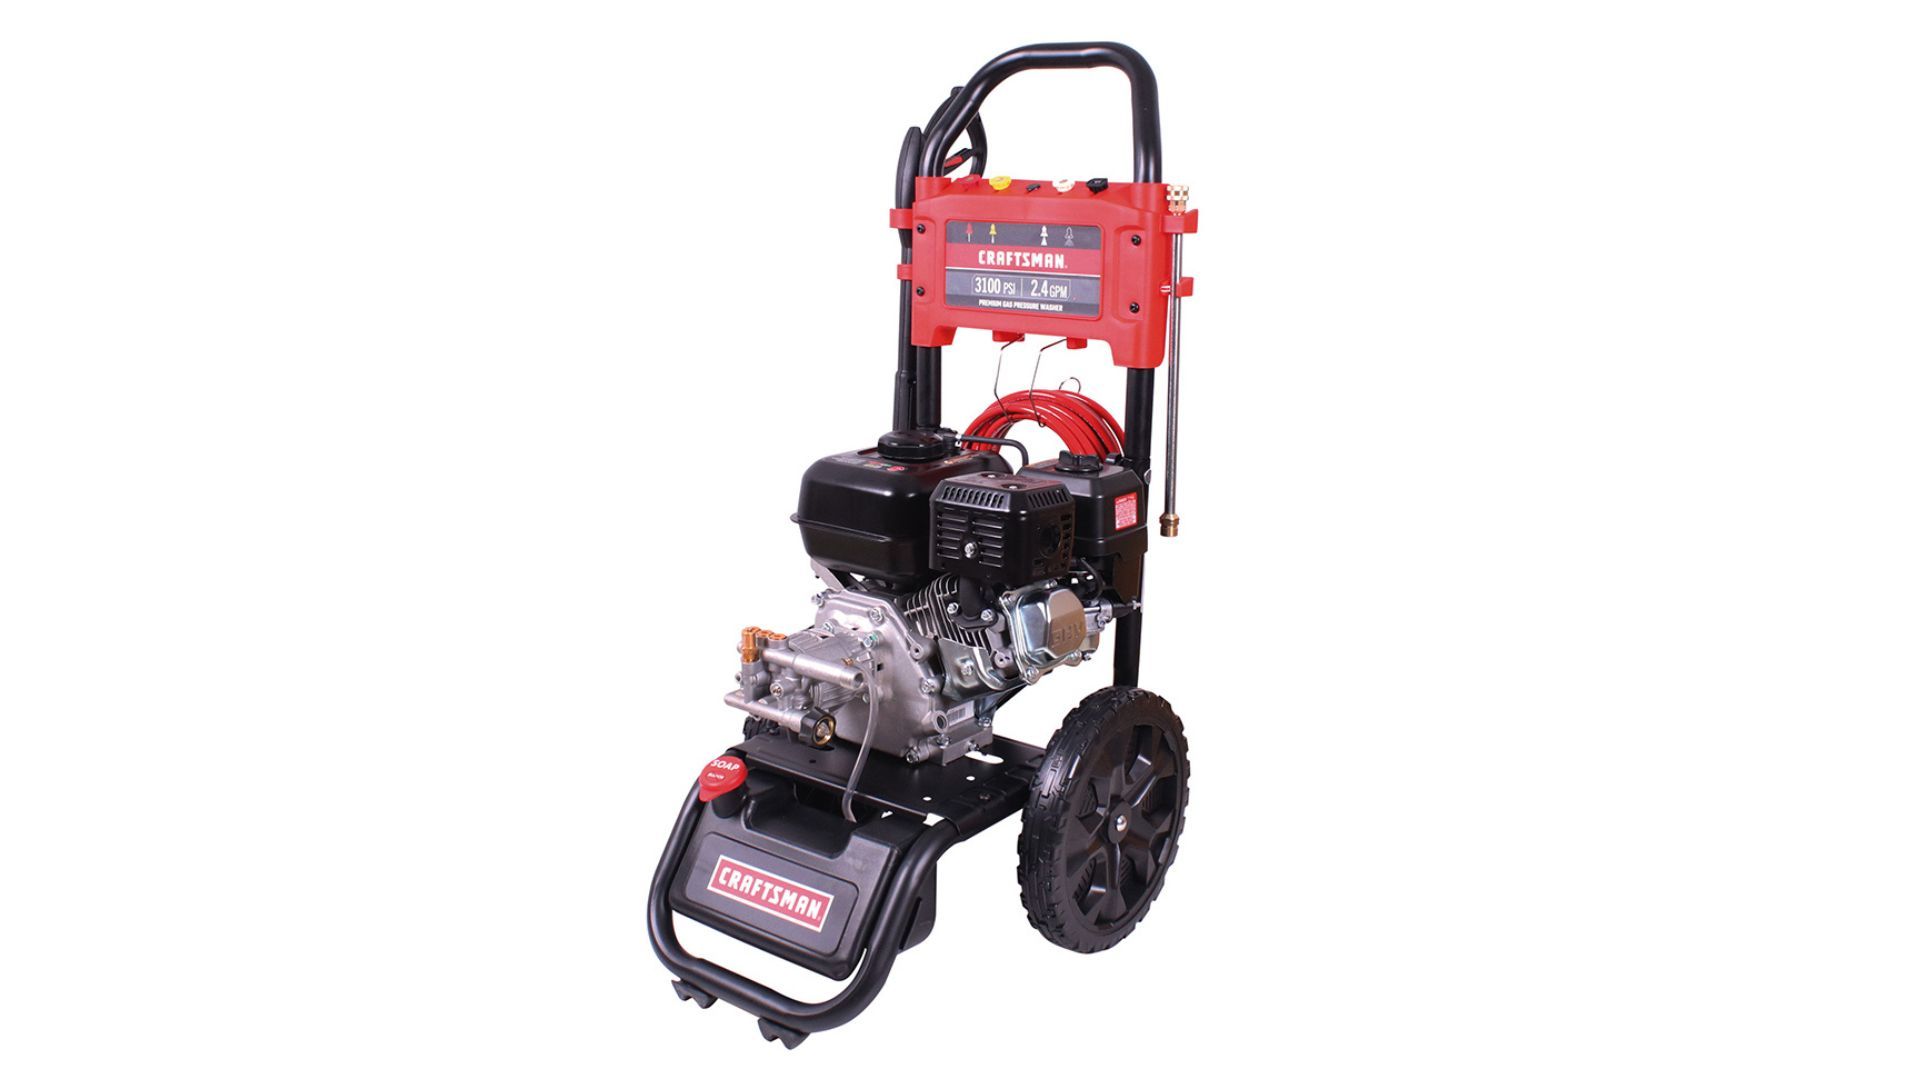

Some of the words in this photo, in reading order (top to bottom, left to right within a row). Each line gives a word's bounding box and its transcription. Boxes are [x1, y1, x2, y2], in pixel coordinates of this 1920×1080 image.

[978, 250, 1065, 269] CRAFTSMAN
[974, 277, 1001, 294] 3100
[1003, 281, 1016, 295] PSI
[1030, 279, 1048, 297] 2.4
[1050, 285, 1068, 299] GPM
[710, 759, 740, 771] SOAP
[718, 867, 822, 920] CRAFTSMAN
